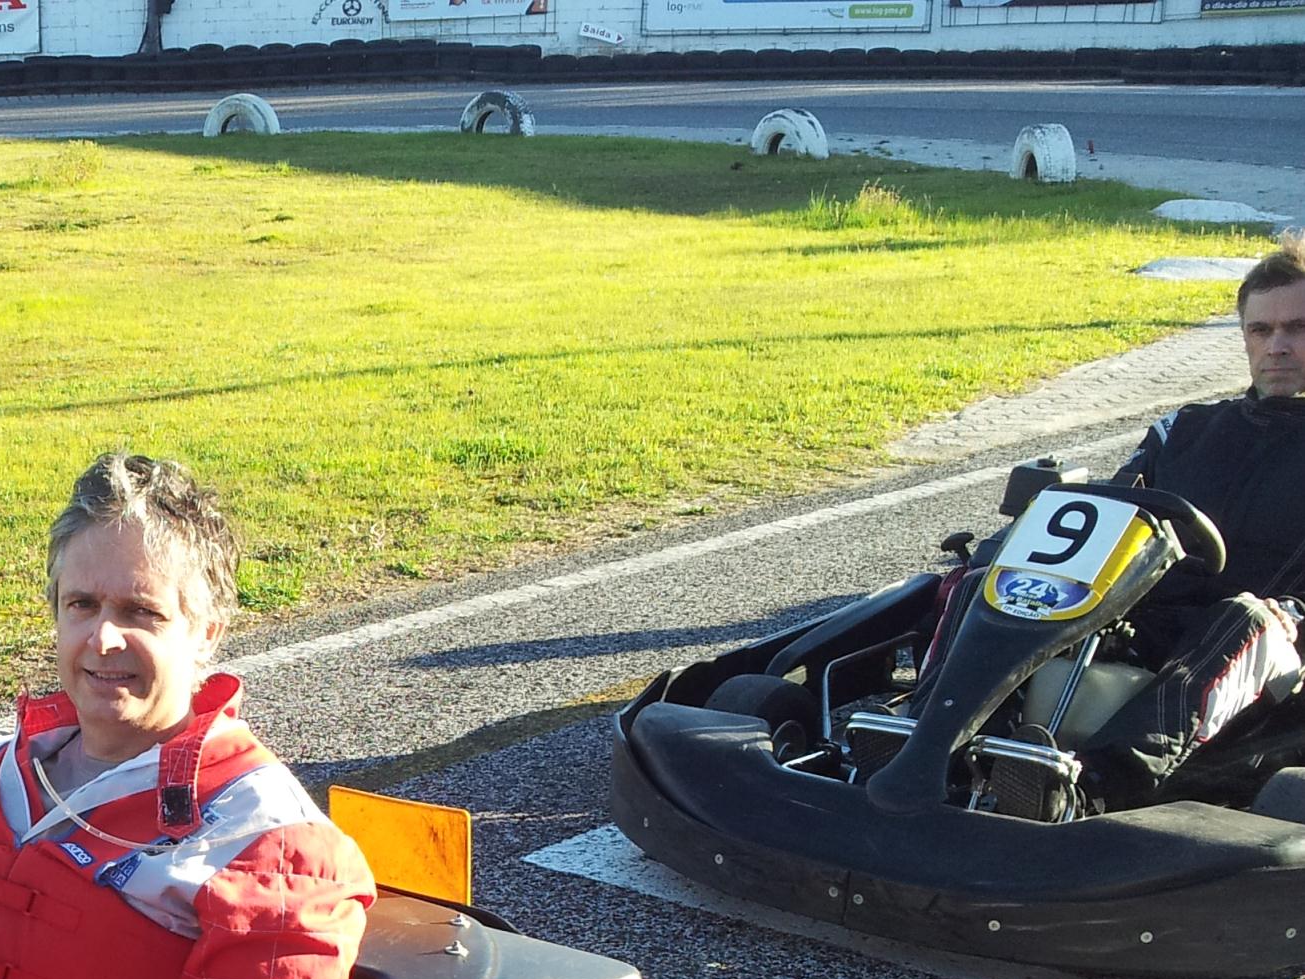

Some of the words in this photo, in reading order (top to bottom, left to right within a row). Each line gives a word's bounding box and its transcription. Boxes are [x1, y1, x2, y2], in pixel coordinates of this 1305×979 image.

[331, 17, 374, 26] EUROINDY
[1026, 500, 1099, 565] 9
[1010, 579, 1048, 599] 24
